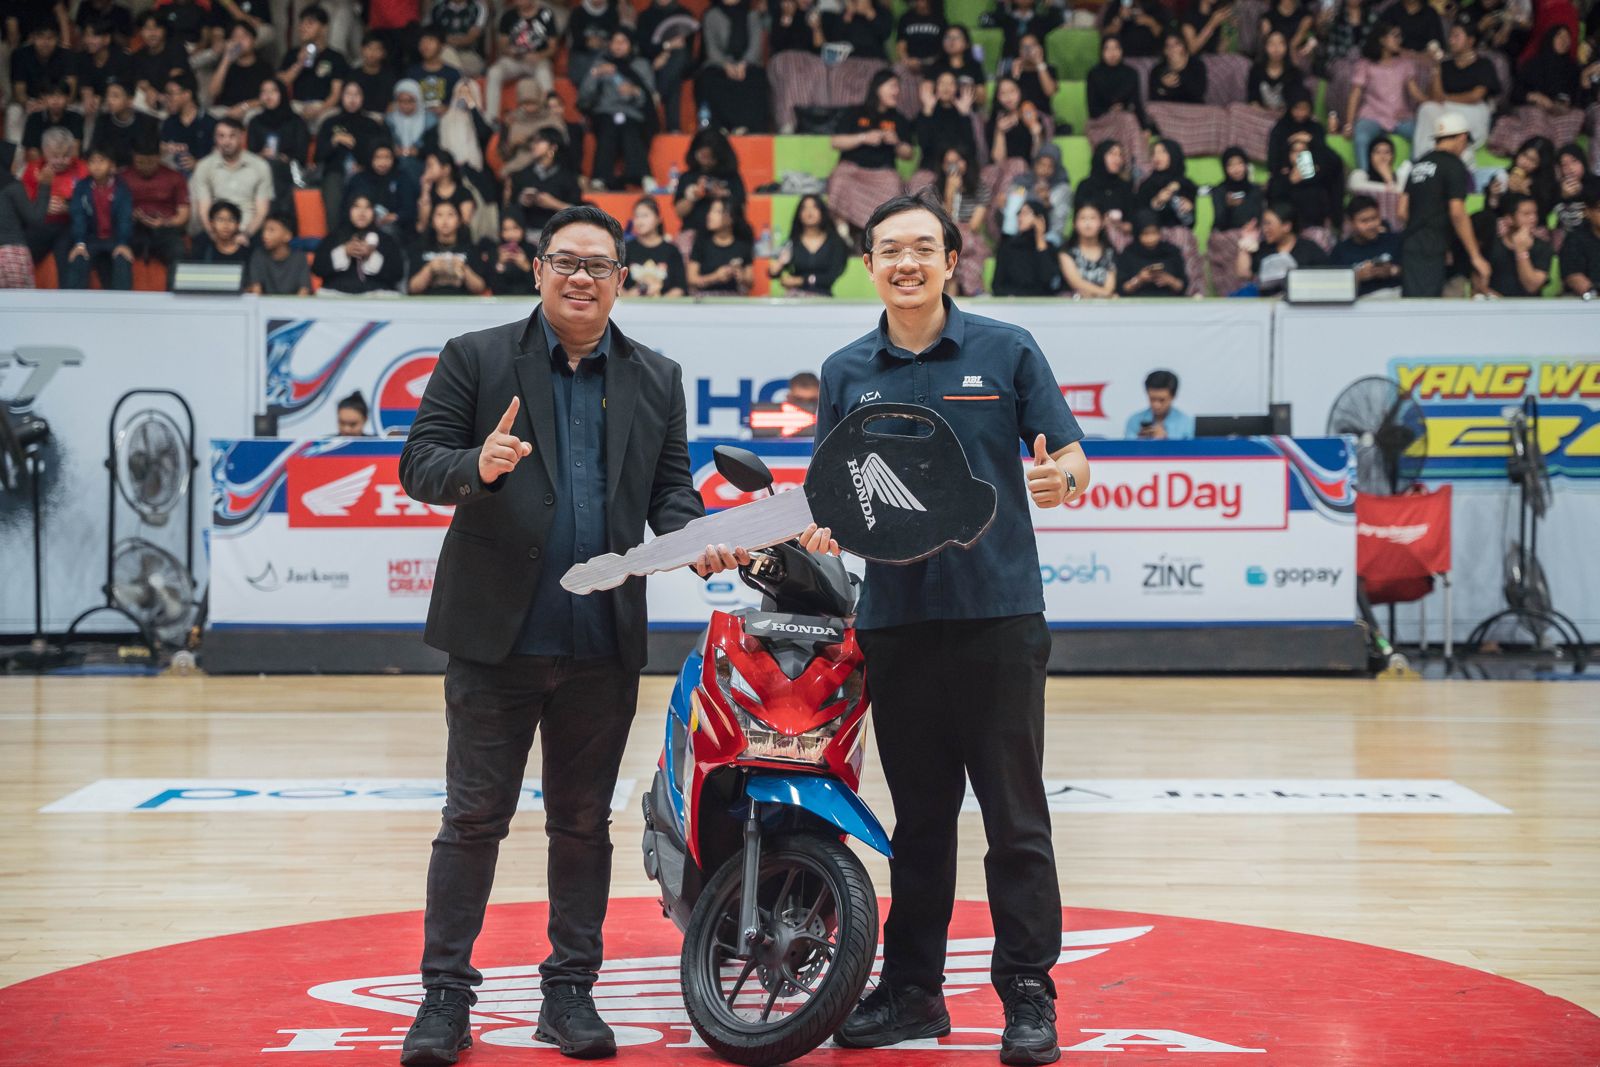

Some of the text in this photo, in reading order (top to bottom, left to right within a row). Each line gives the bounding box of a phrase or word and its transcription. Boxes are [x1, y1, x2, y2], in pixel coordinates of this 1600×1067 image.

[1396, 363, 1531, 399] YANG
[374, 483, 456, 517] H
[846, 458, 877, 532] HONDA
[1167, 471, 1243, 519] Day
[387, 559, 422, 576] HOT
[1273, 566, 1343, 588] gopay
[770, 621, 839, 637] HONDA
[133, 787, 544, 809] pos
[260, 1025, 1269, 1054] HODA
